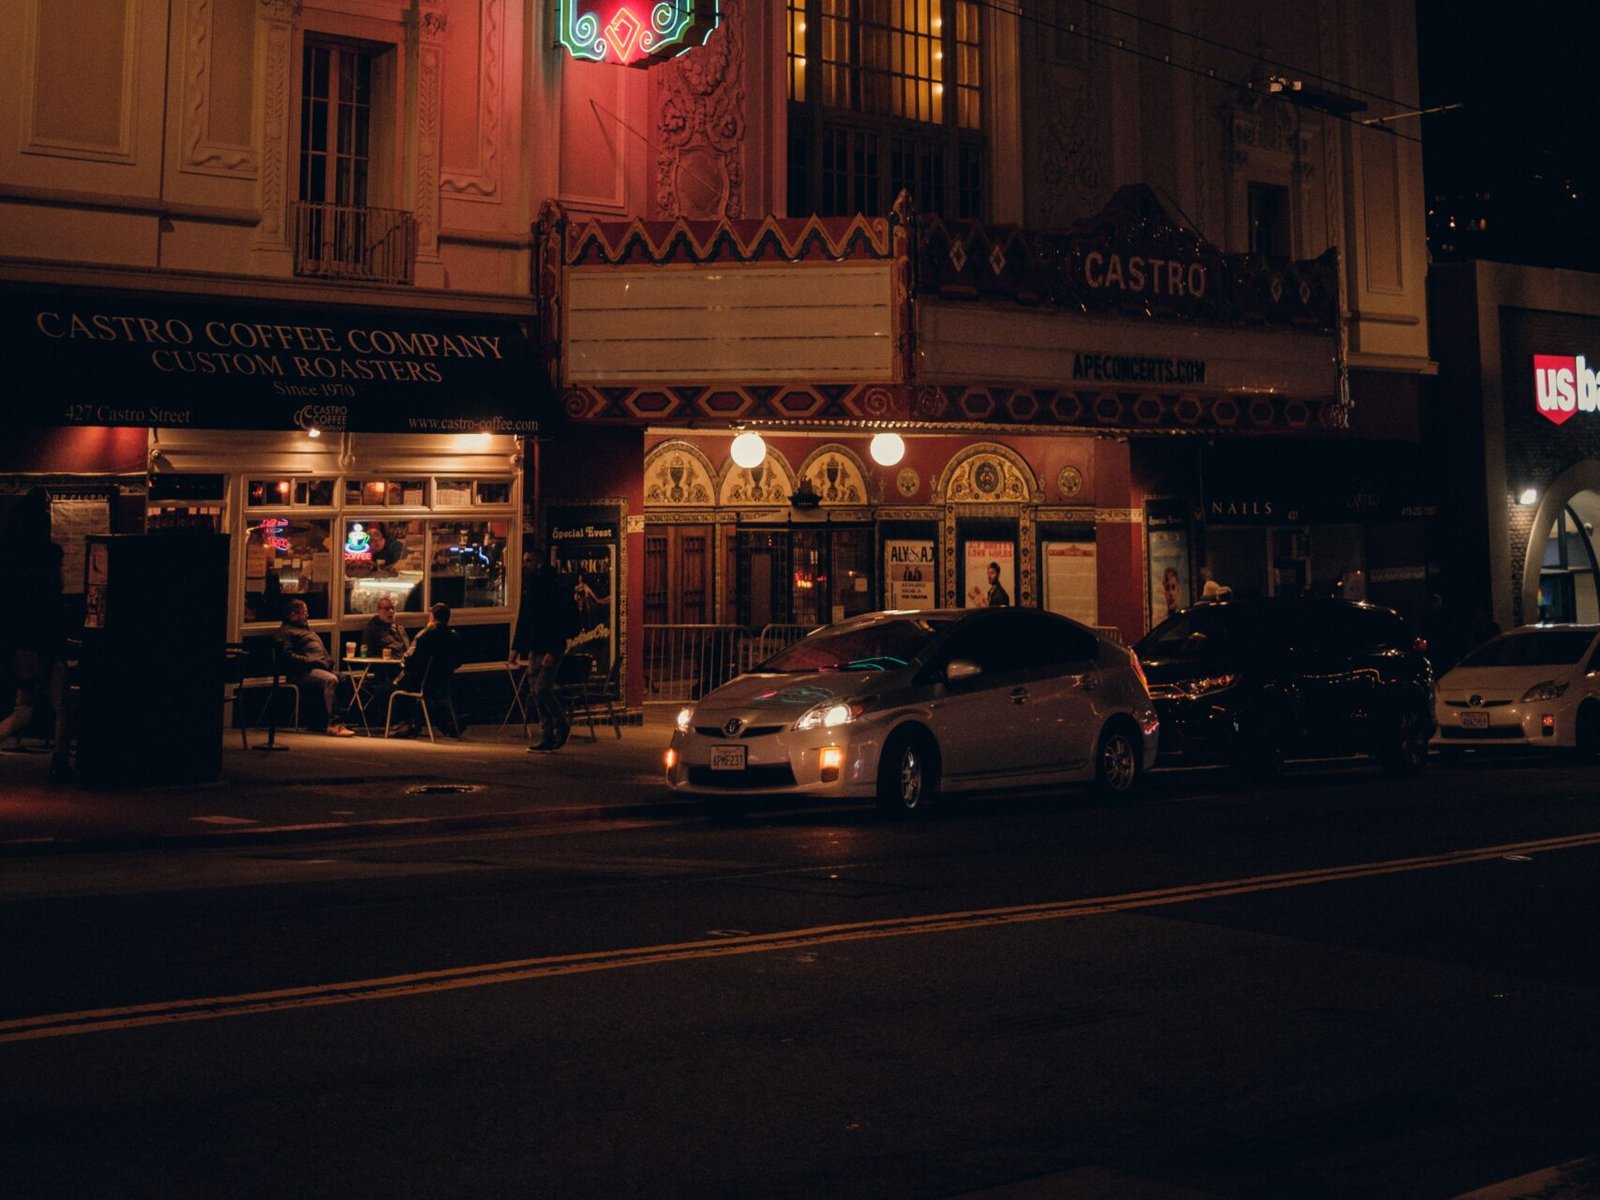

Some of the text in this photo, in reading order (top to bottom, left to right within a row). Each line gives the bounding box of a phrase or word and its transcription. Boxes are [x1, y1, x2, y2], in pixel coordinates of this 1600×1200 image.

[1084, 251, 1206, 298] CASTRO
[35, 311, 504, 360] CASTRO COFFEE COMPANY
[151, 349, 444, 384] CUSTOM ROASTERS
[1073, 353, 1205, 385] APECONCERTS.COM
[273, 380, 355, 398] Since 1970
[65, 405, 191, 423] 427 Castro Street
[313, 405, 348, 416] CASTRO
[312, 415, 348, 425] COFFEE
[408, 415, 538, 432] www.castro-coffee.com
[1211, 502, 1273, 516] NAILS
[552, 525, 612, 540] Special Event
